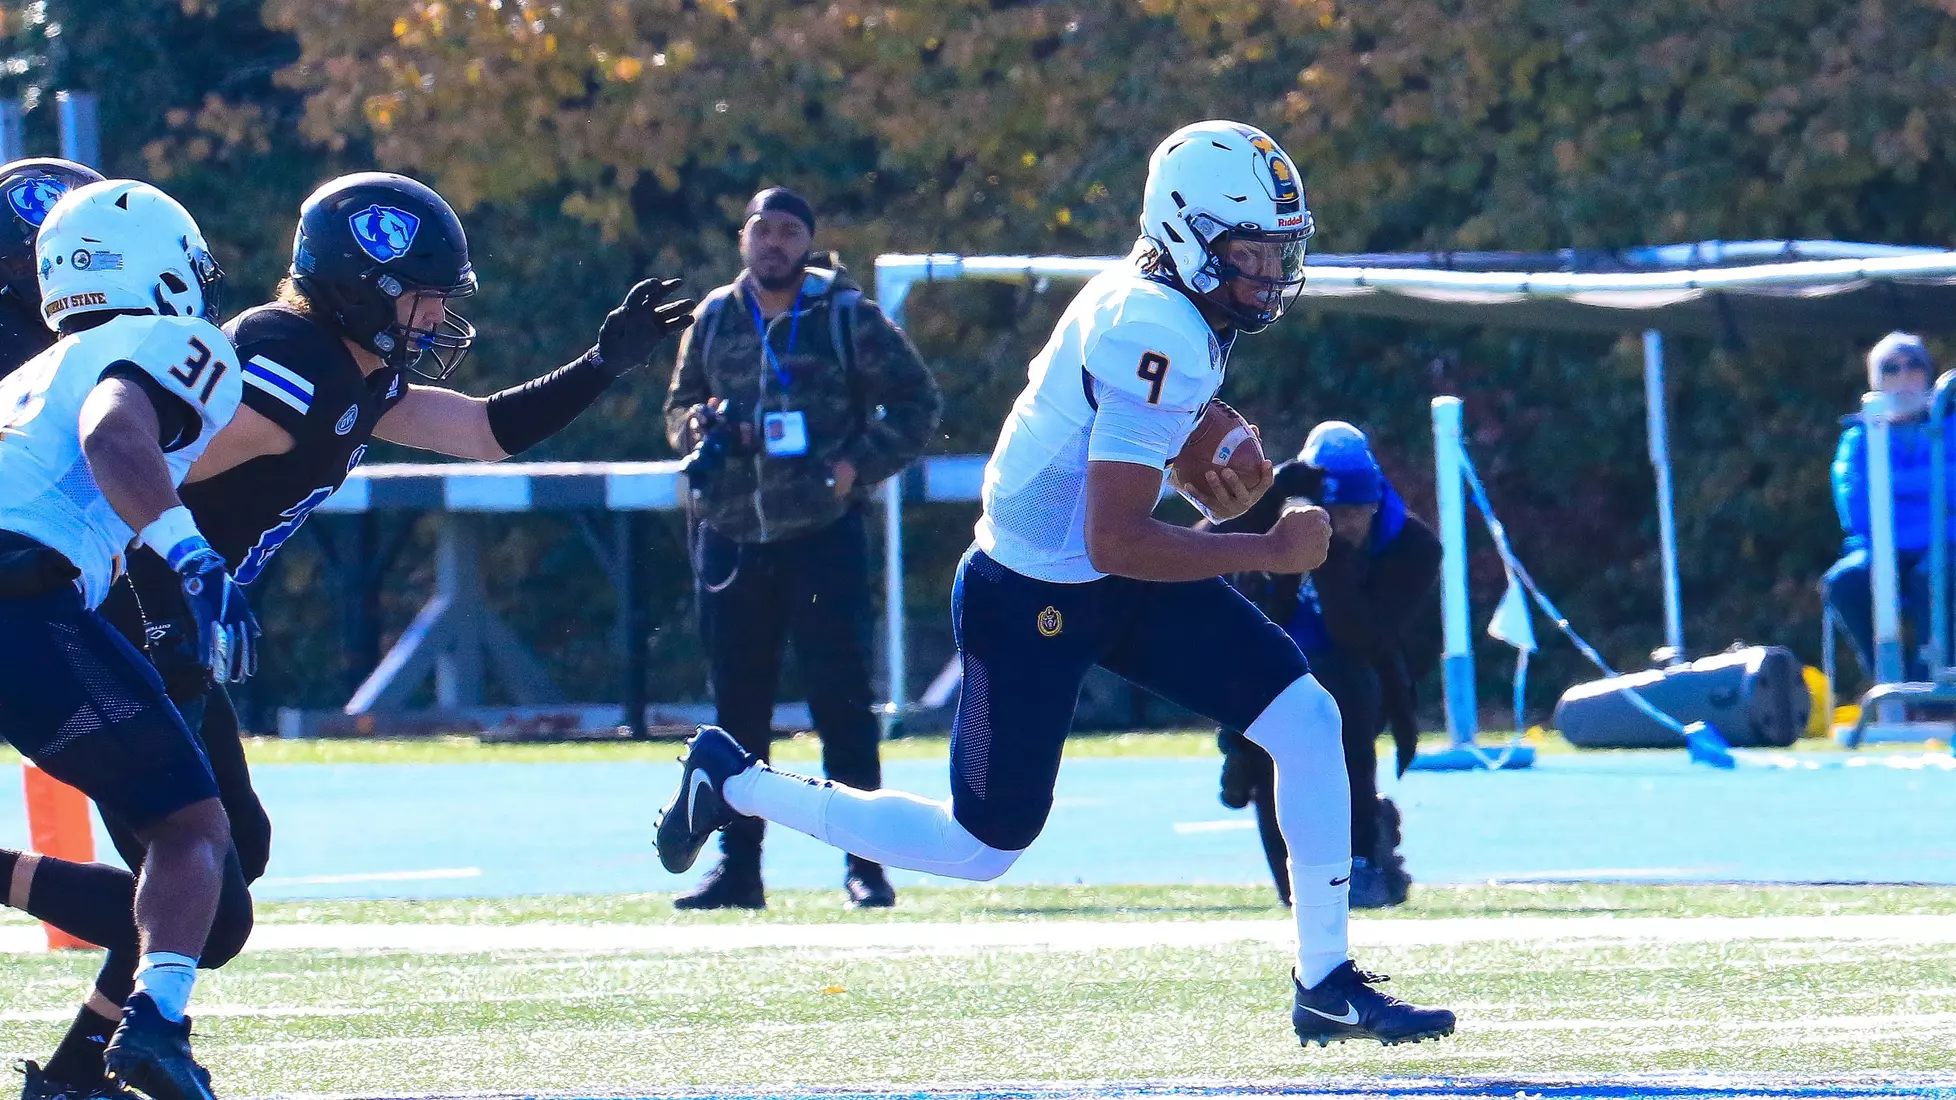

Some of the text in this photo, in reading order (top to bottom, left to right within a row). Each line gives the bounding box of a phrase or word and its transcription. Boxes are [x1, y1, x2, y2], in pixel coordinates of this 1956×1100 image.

[1277, 214, 1303, 227] Riddell
[70, 292, 108, 307] STATE
[167, 334, 229, 407] 31
[1136, 349, 1171, 406] 9
